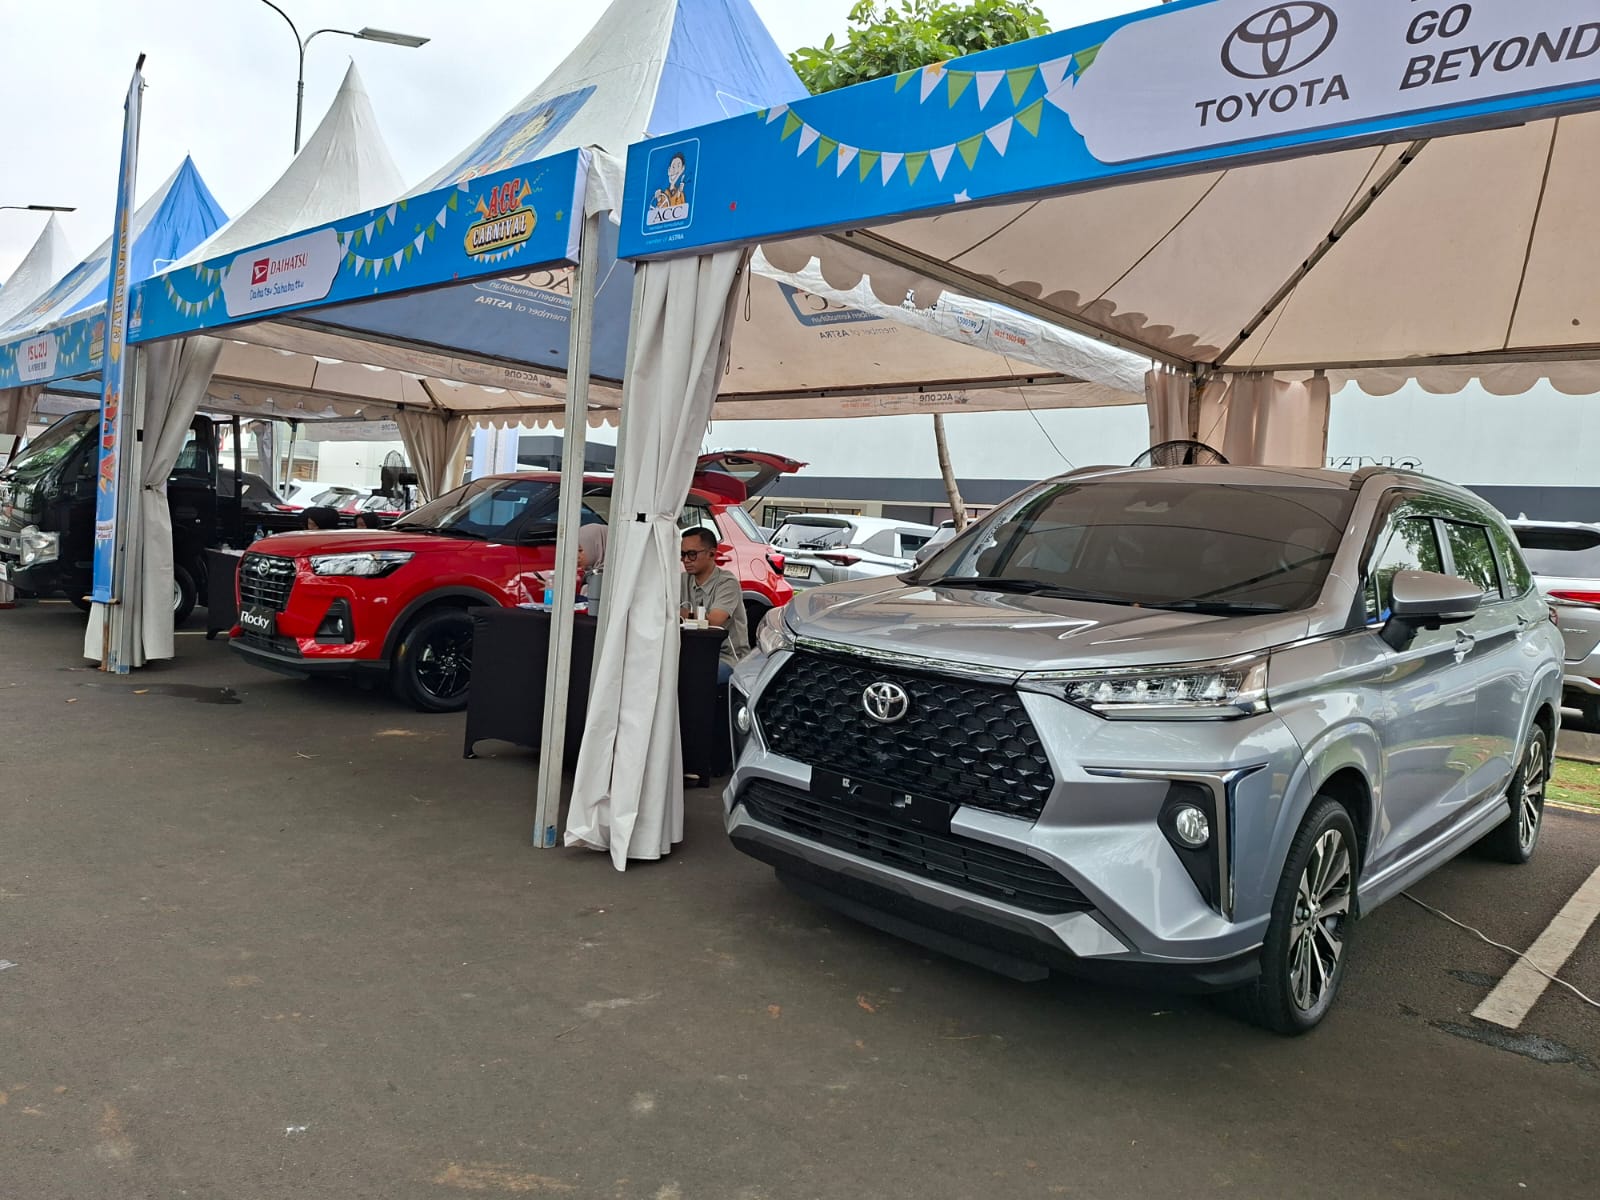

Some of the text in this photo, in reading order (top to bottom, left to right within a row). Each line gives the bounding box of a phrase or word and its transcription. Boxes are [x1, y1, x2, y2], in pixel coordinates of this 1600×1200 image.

[1406, 3, 1472, 44] GO
[1399, 22, 1600, 90] BEYOND
[1195, 74, 1350, 127] TOYOTA
[487, 178, 521, 220] ACC
[653, 206, 683, 223] ACC
[473, 215, 528, 248] CARNIVAL
[270, 252, 308, 275] DAIHATSU
[241, 611, 270, 629] Rocky
